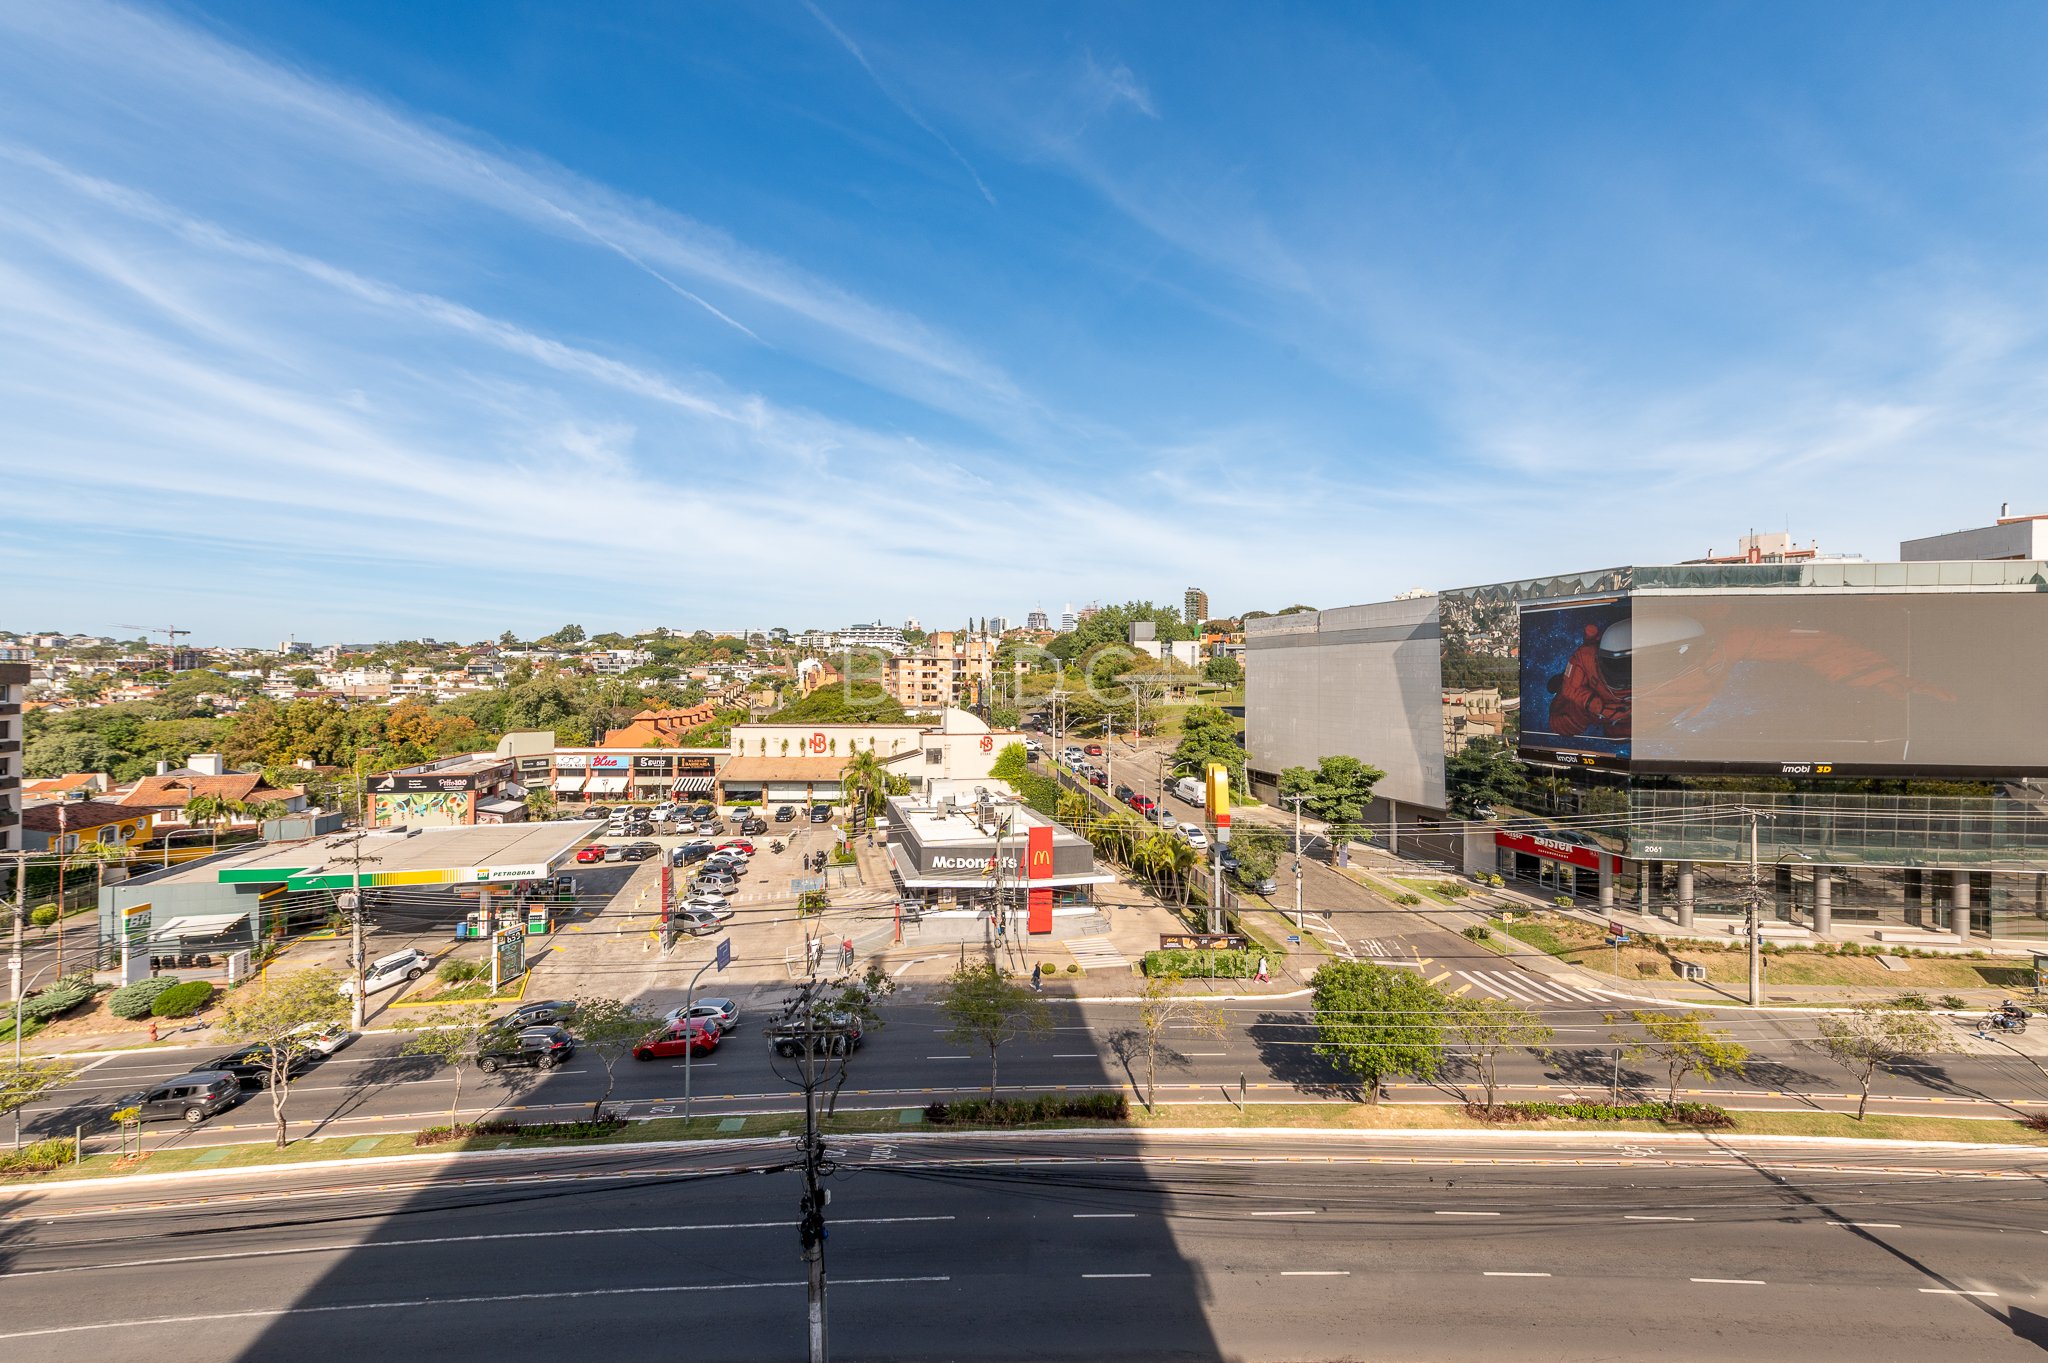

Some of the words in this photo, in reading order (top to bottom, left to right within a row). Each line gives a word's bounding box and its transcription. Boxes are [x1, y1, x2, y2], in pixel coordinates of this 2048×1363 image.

[592, 755, 618, 767] Blue
[1782, 765, 1810, 774] imobi
[1816, 765, 1832, 773] 3D
[932, 856, 1018, 869] McDonad's
